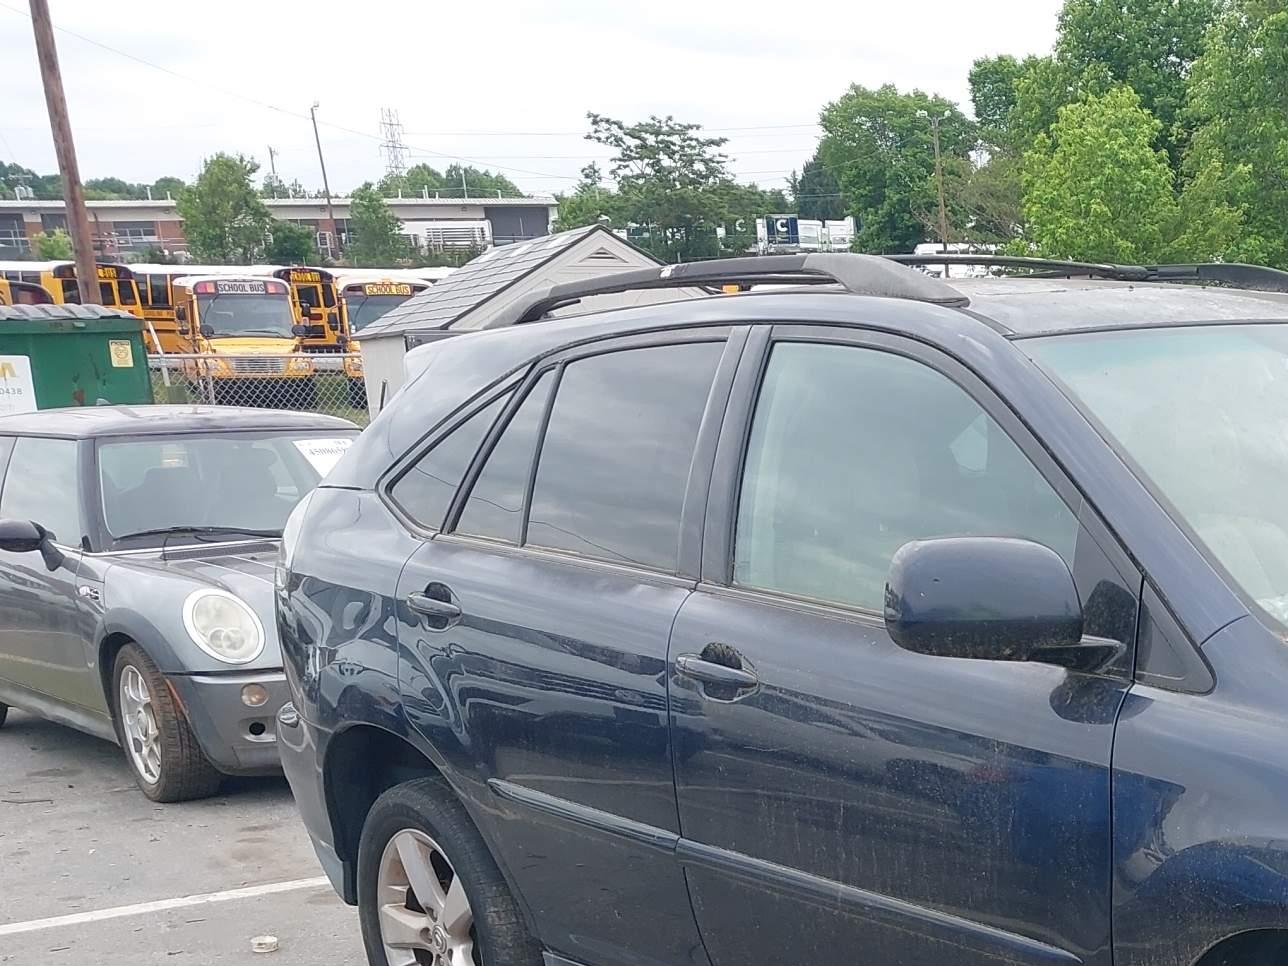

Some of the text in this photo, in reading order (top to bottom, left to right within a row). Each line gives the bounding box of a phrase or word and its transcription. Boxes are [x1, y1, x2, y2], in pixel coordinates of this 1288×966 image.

[218, 283, 265, 292] SCHOOL BUS
[367, 286, 409, 294] SCHOOL BUS
